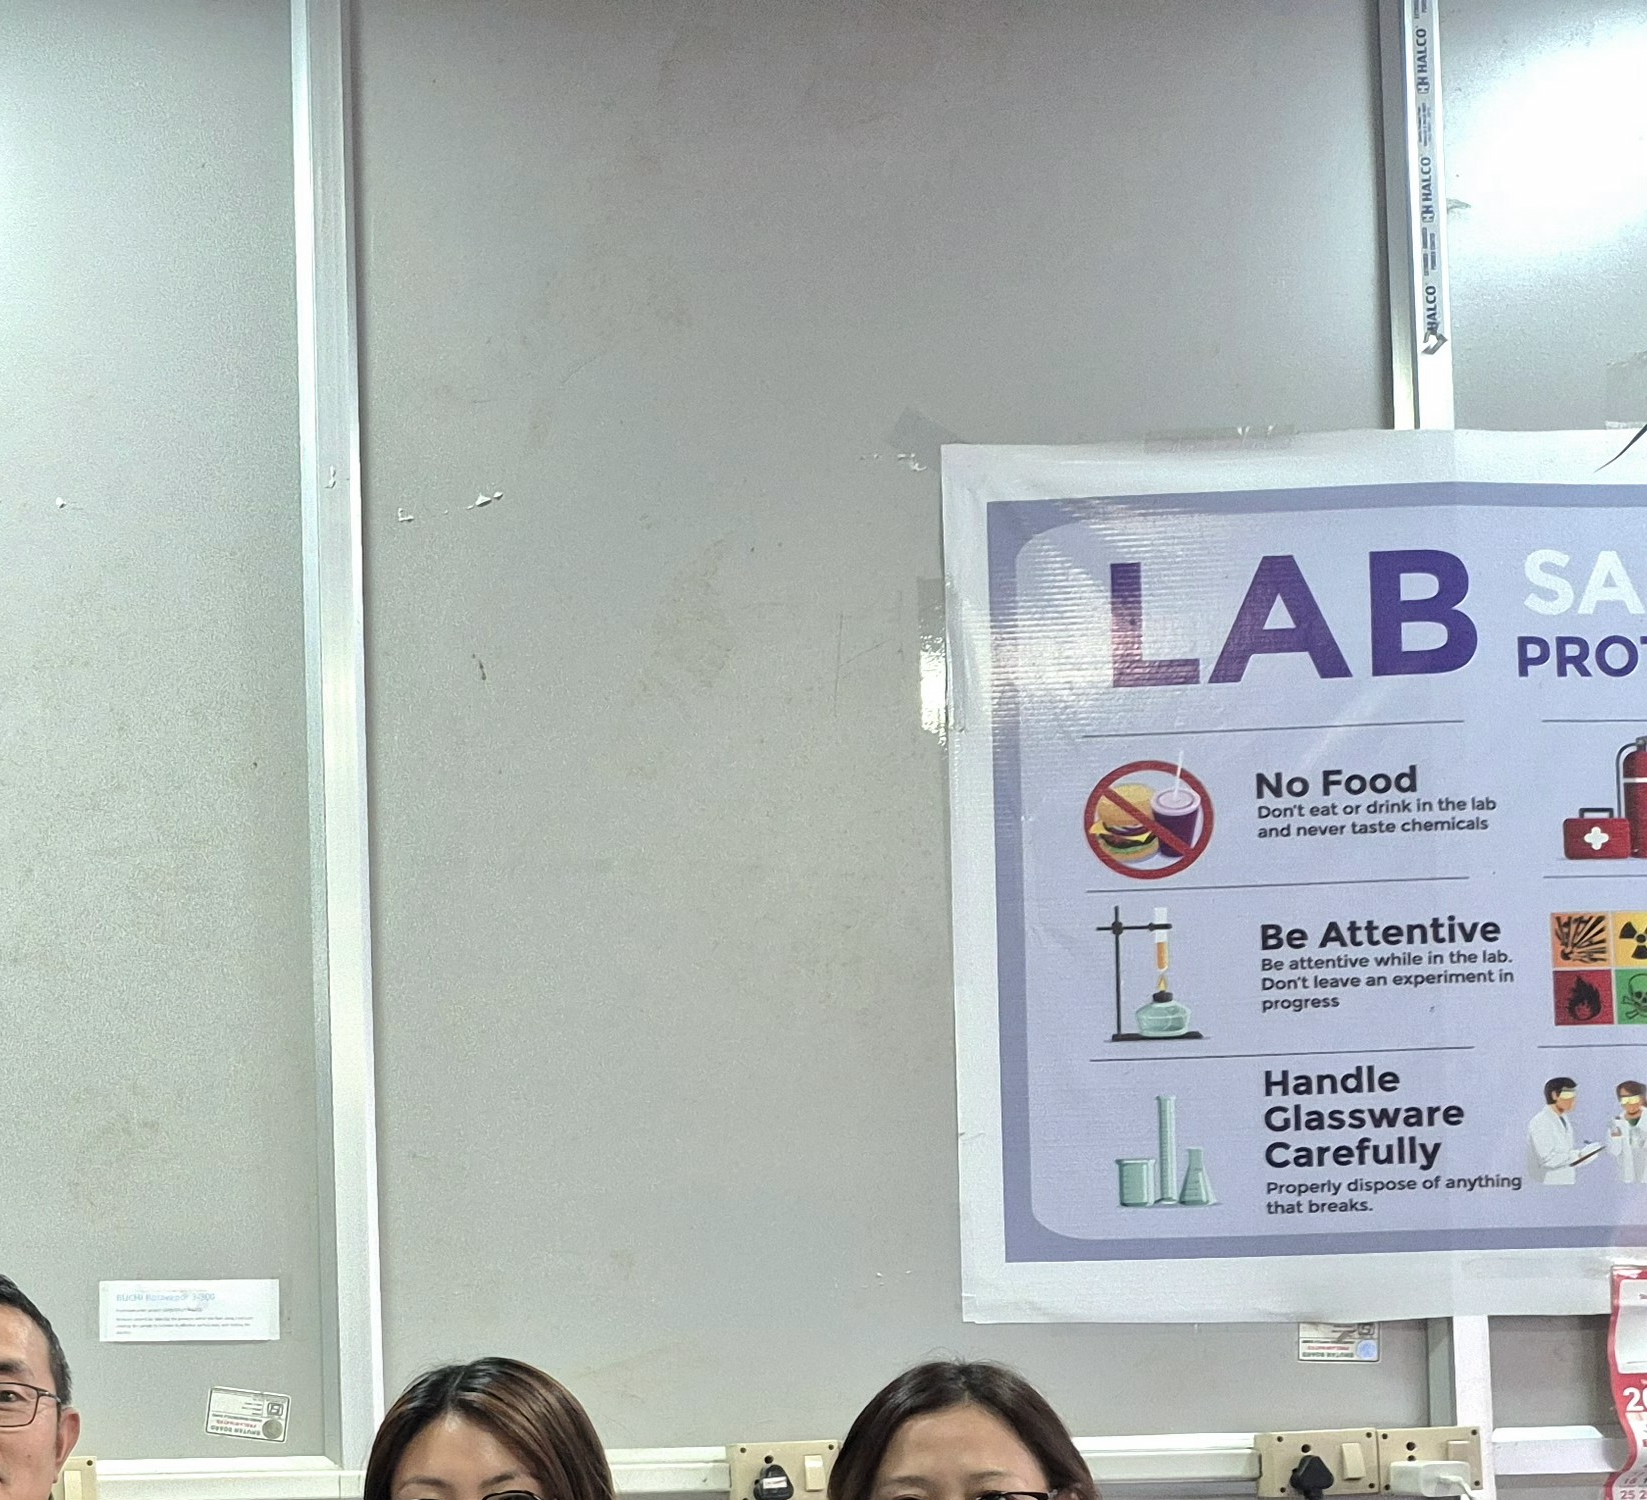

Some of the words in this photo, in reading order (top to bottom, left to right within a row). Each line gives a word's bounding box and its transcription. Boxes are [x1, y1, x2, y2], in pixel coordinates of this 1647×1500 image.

[1416, 27, 1428, 74] HALCO
[1421, 156, 1433, 203] HALCO
[1523, 550, 1646, 615] SA
[1110, 549, 1478, 688] LAB
[1256, 771, 1310, 800] No
[1322, 764, 1418, 796] Food
[1257, 803, 1305, 819] Don't
[1309, 802, 1338, 816] eat
[1343, 803, 1361, 815] or
[1366, 798, 1413, 815] drink
[1415, 798, 1433, 813] in
[1437, 796, 1467, 812] the
[1471, 796, 1497, 811] lab
[1257, 823, 1291, 838] and
[1296, 824, 1346, 837] never
[1351, 820, 1396, 835] taste
[1401, 816, 1489, 833] chemicals
[1260, 923, 1309, 950] Be
[1318, 915, 1502, 948] Attentive
[1261, 957, 1285, 971] Be
[1289, 953, 1370, 970] attentive
[1374, 951, 1424, 968] while
[1427, 950, 1445, 965] in
[1449, 950, 1478, 964] the
[1482, 949, 1514, 964] lab.
[1261, 975, 1310, 991] Don't
[1314, 974, 1361, 989] leave
[1365, 976, 1388, 987] an
[1392, 970, 1496, 988] experiment
[1498, 969, 1515, 983] in
[1262, 995, 1340, 1013] progress
[1264, 1064, 1400, 1097] Handle
[1264, 1103, 1465, 1132] Glassware
[1265, 1136, 1442, 1171] Carefully
[1267, 1179, 1342, 1197] Properly
[1347, 1177, 1417, 1194] dispose
[1422, 1175, 1442, 1190] of
[1445, 1173, 1523, 1191] anything
[1267, 1200, 1304, 1214] that
[1308, 1198, 1374, 1213] breaks.
[1619, 1489, 1636, 1500] 25
